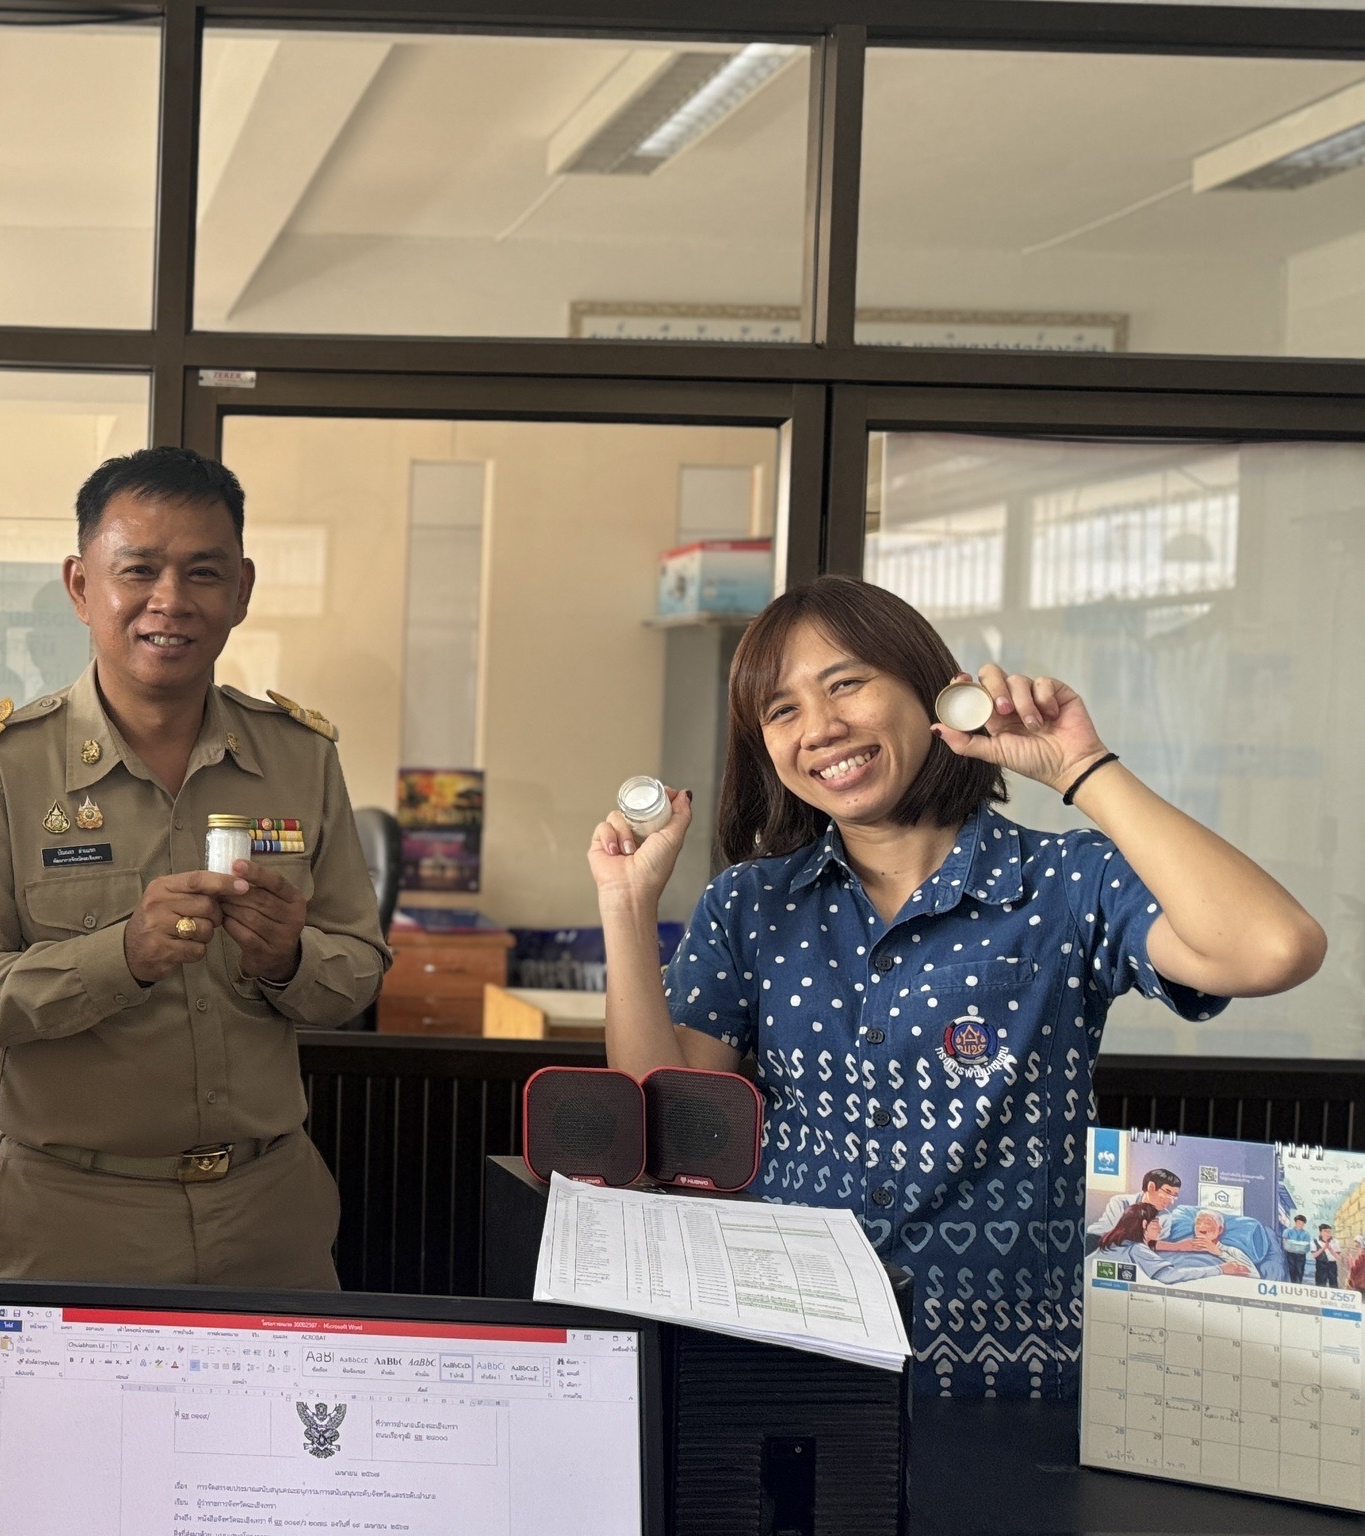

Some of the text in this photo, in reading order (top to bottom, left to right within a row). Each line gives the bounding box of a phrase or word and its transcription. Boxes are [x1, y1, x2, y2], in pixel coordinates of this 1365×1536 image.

[1257, 1282, 1356, 1303] 04 เมษายน 2567
